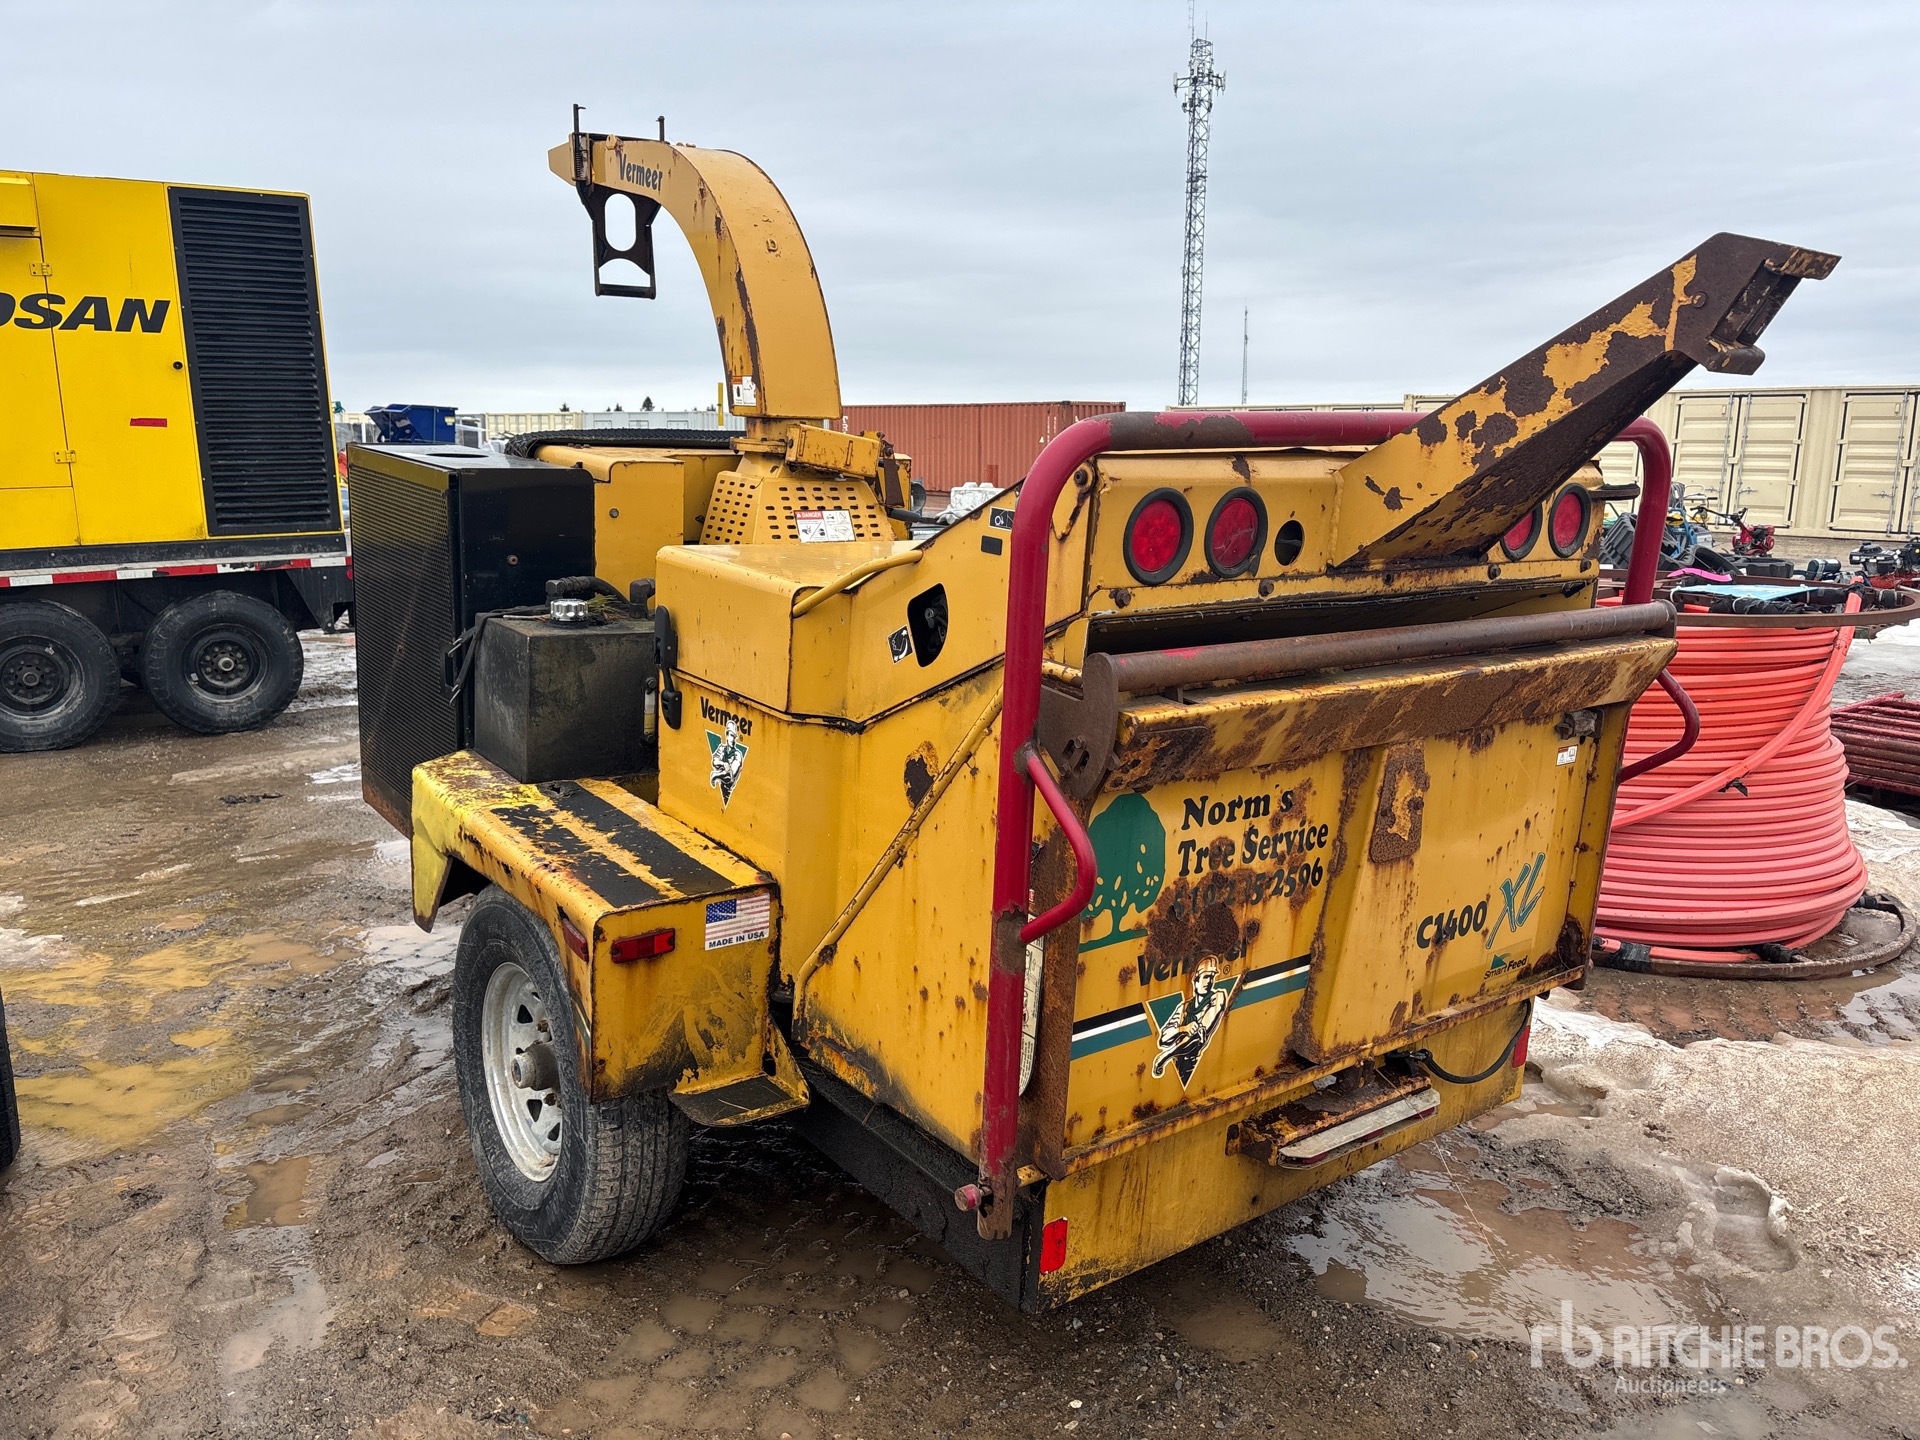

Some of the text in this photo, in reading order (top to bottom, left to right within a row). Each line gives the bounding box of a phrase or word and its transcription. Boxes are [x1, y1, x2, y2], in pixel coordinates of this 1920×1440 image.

[619, 153, 663, 192] Vermeer
[700, 695, 753, 737] Vermeer
[1178, 817, 1329, 877] Tree Service
[1416, 852, 1546, 950] C1400 XL
[708, 937, 733, 948] MADE
[747, 931, 764, 940] USA
